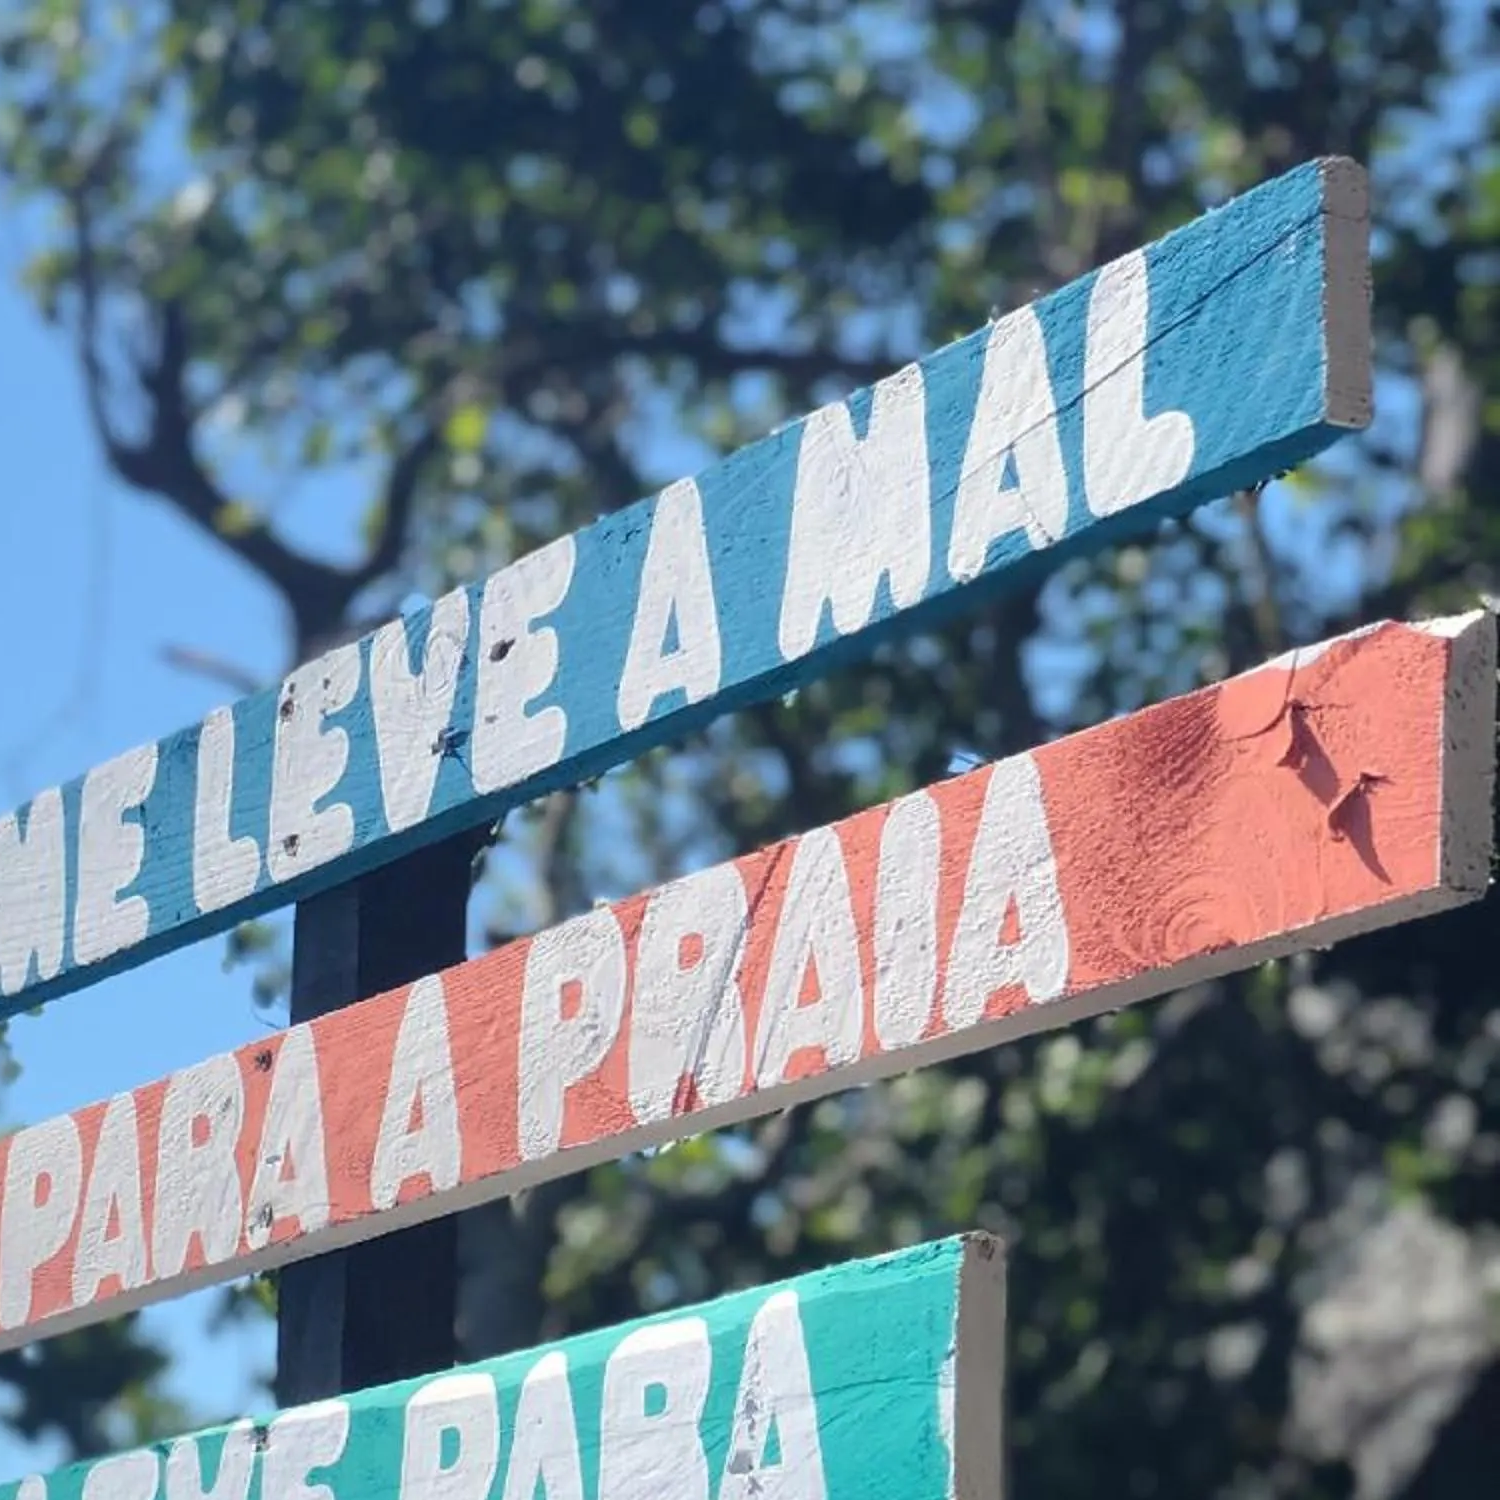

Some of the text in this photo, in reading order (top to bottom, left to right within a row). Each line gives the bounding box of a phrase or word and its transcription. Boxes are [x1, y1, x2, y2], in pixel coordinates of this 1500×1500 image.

[193, 534, 576, 913] LEVE
[617, 477, 722, 732] A
[778, 248, 1196, 662] MAL
[370, 973, 462, 1210] A
[517, 752, 1071, 1162] PRAIA
